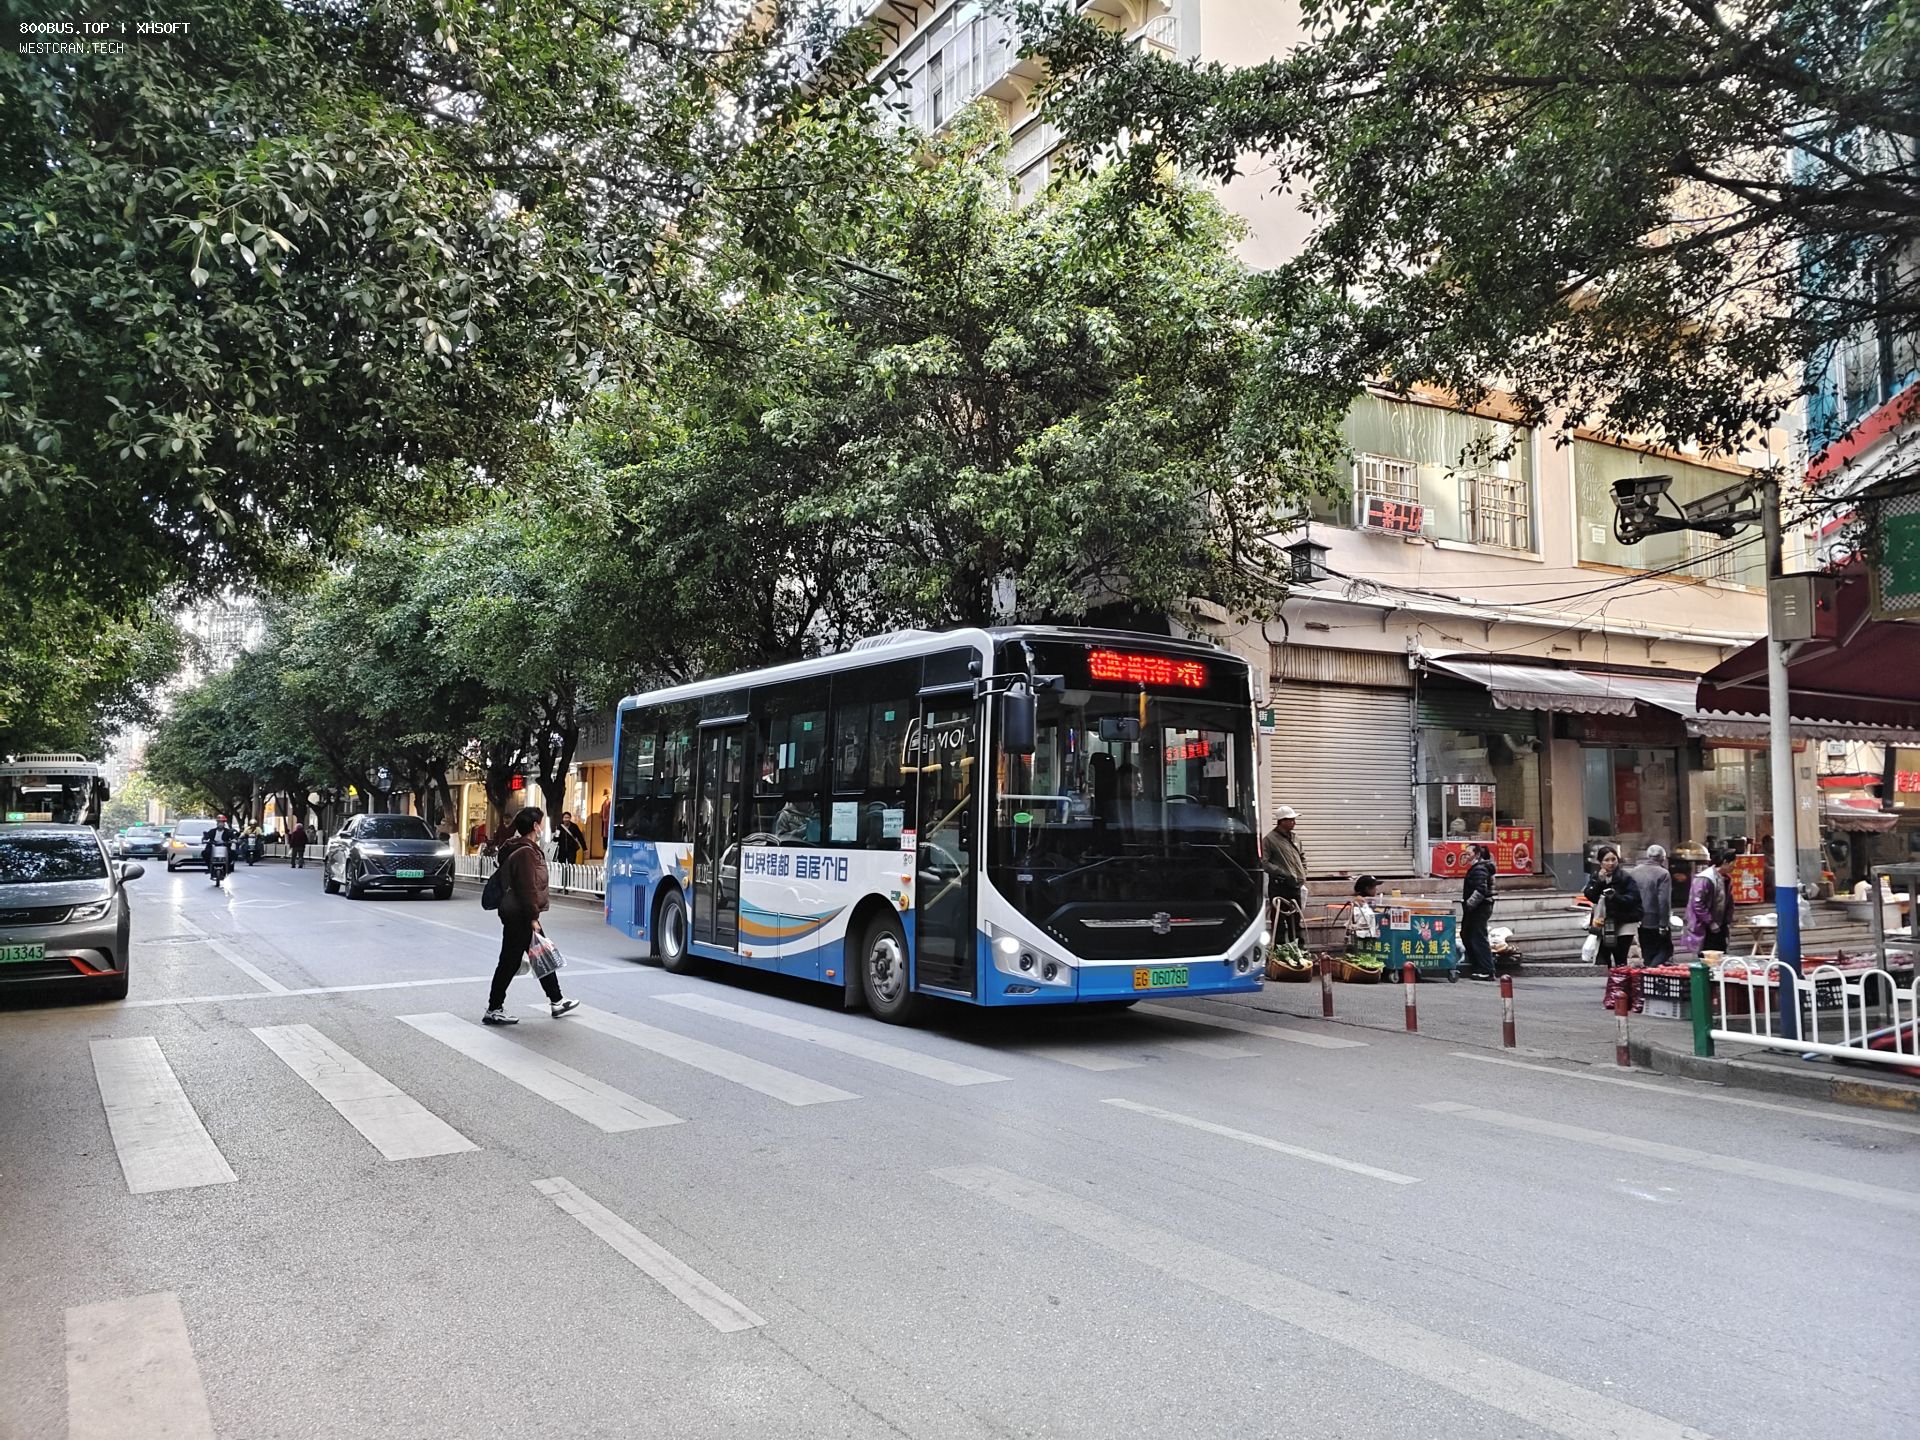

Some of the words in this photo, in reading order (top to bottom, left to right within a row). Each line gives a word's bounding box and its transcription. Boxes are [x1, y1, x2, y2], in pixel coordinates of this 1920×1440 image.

[744, 852, 790, 877] 世界锡都
[796, 855, 848, 882] 宜居个旧
